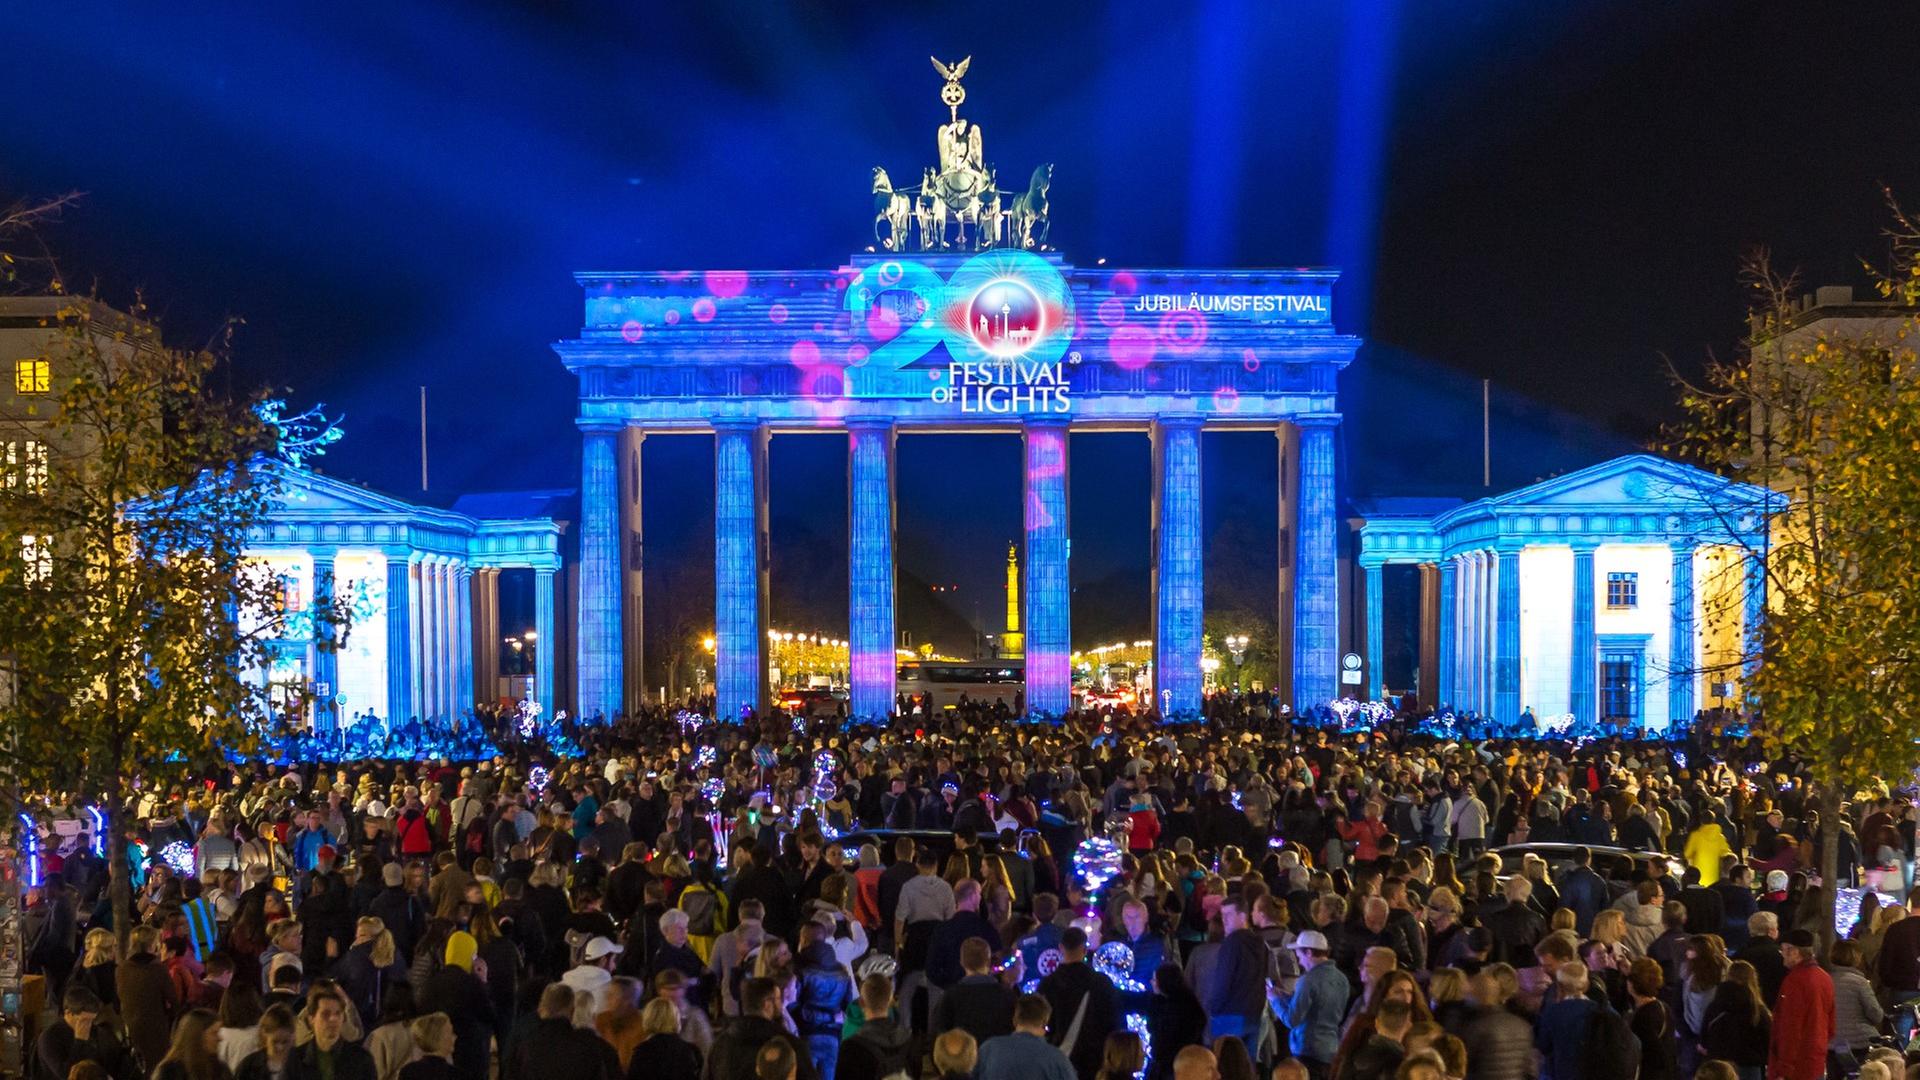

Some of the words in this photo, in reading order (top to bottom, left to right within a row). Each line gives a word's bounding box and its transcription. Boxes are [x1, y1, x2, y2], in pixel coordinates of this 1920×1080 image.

[1134, 292, 1327, 312] JUBILÄUMSFESTIVAL
[949, 361, 1071, 386] FESTIVAL
[931, 386, 959, 404] OF
[961, 385, 1071, 413] LIGHTS
